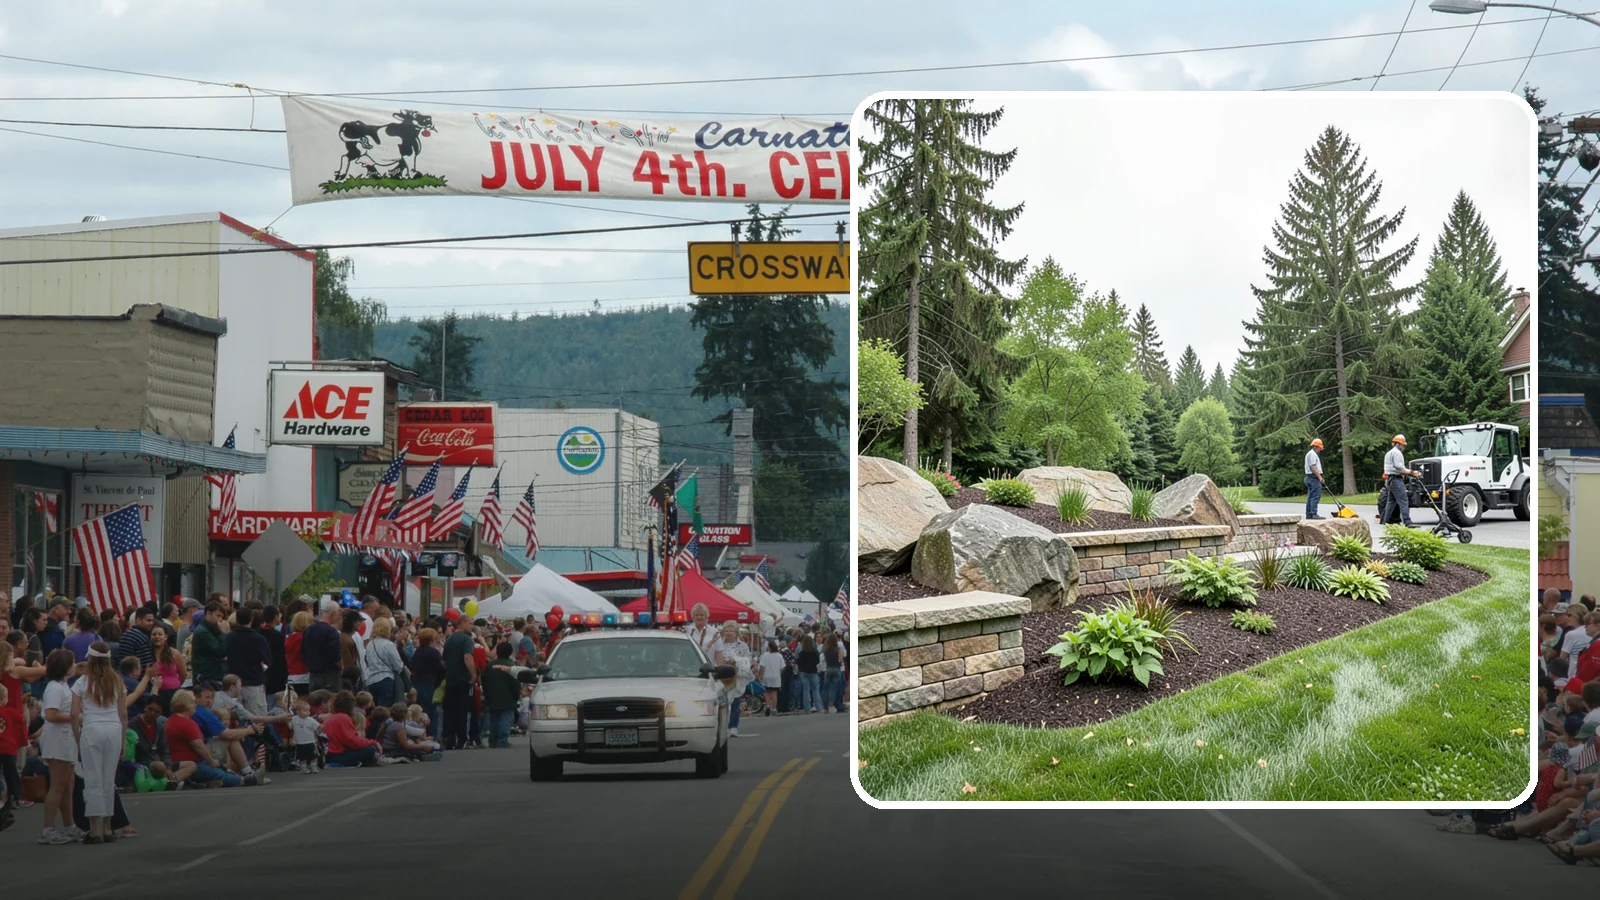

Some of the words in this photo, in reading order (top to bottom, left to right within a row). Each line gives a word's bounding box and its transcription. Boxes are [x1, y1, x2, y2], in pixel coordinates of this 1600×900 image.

[481, 141, 605, 192] JULY
[632, 150, 746, 198] 4th.
[697, 254, 850, 280] CROSSWA
[283, 380, 373, 420] ACE
[405, 409, 453, 423] CEDAR
[283, 421, 371, 436] Hardware
[416, 428, 477, 447] Coca-Cola
[353, 467, 384, 481] Simpl
[95, 484, 124, 495] Vincent
[126, 486, 136, 494] de
[137, 486, 155, 495] Paul
[688, 526, 741, 535] CRNATION
[699, 535, 730, 544] GLASS
